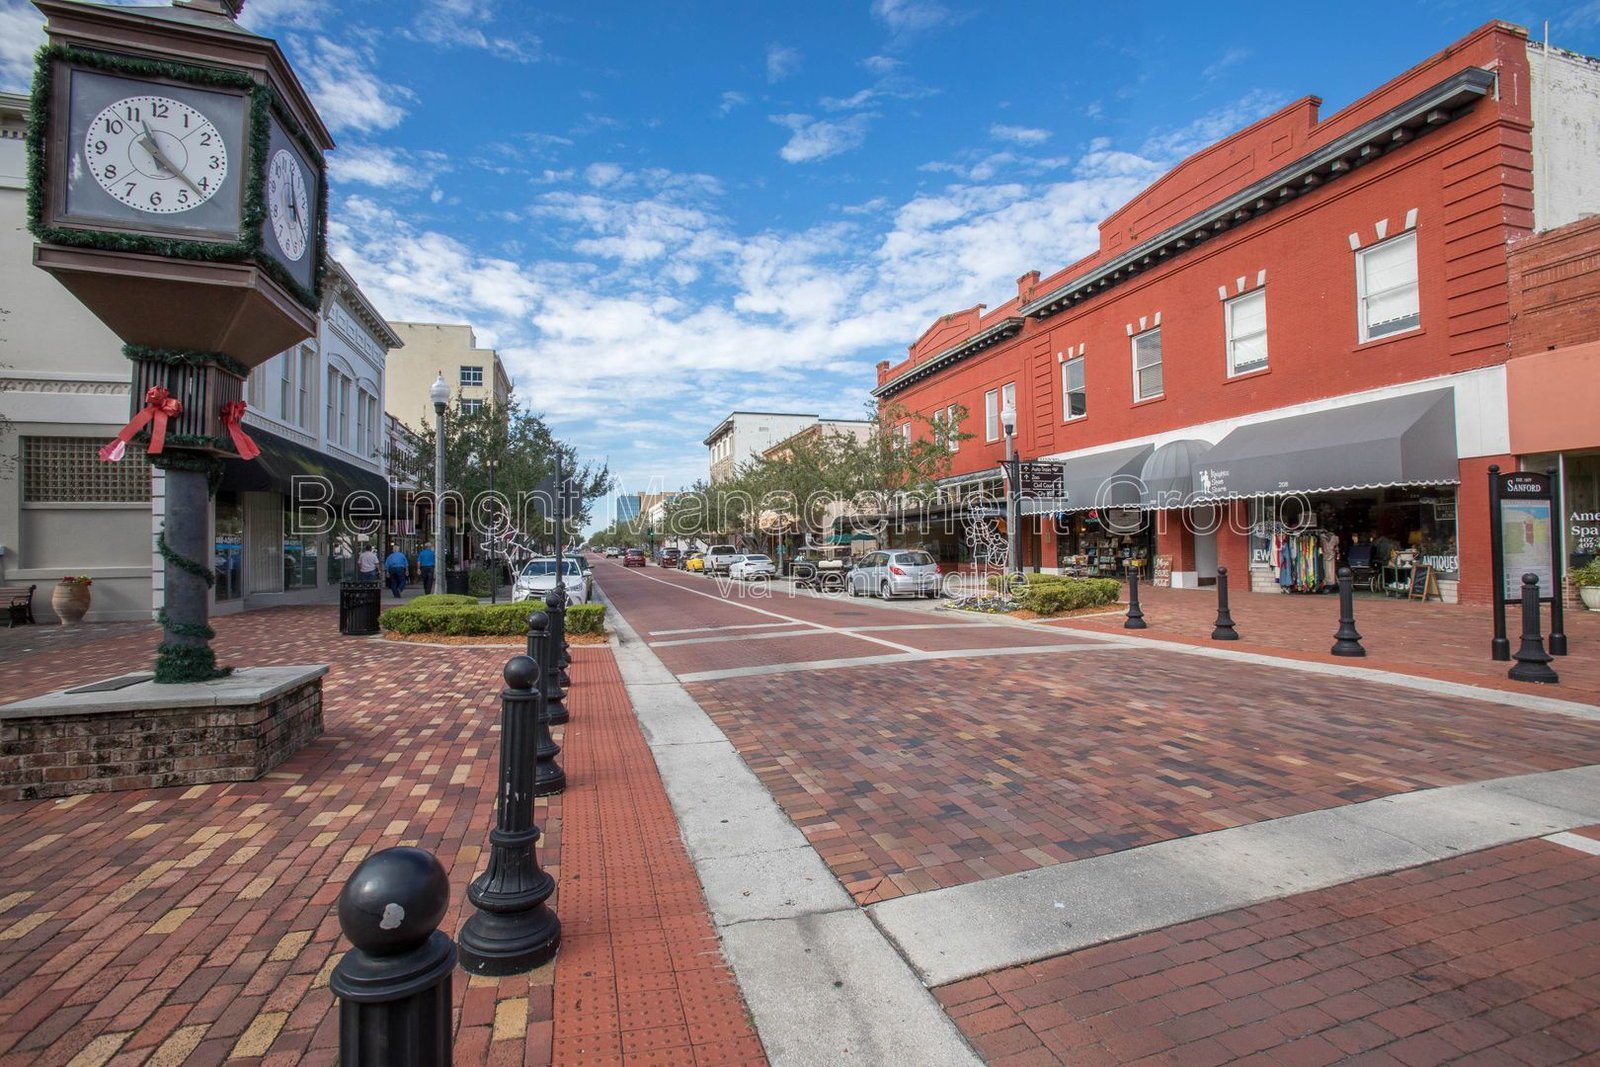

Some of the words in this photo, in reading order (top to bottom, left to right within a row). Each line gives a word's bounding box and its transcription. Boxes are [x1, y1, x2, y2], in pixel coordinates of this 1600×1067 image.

[127, 106, 140, 123] 11
[151, 102, 168, 119] 12
[105, 118, 123, 135] 10
[184, 113, 189, 129] 1
[95, 140, 107, 155] 9
[199, 132, 211, 147] 2
[208, 155, 220, 170] 3
[104, 164, 117, 180] 8
[124, 182, 137, 197] 7
[197, 176, 209, 192] 4
[150, 191, 162, 207] 6
[177, 189, 188, 204] 5
[1507, 479, 1541, 492] SANFORD
[1571, 525, 1599, 537] Spa
[1422, 555, 1459, 571] ANTIQUES
